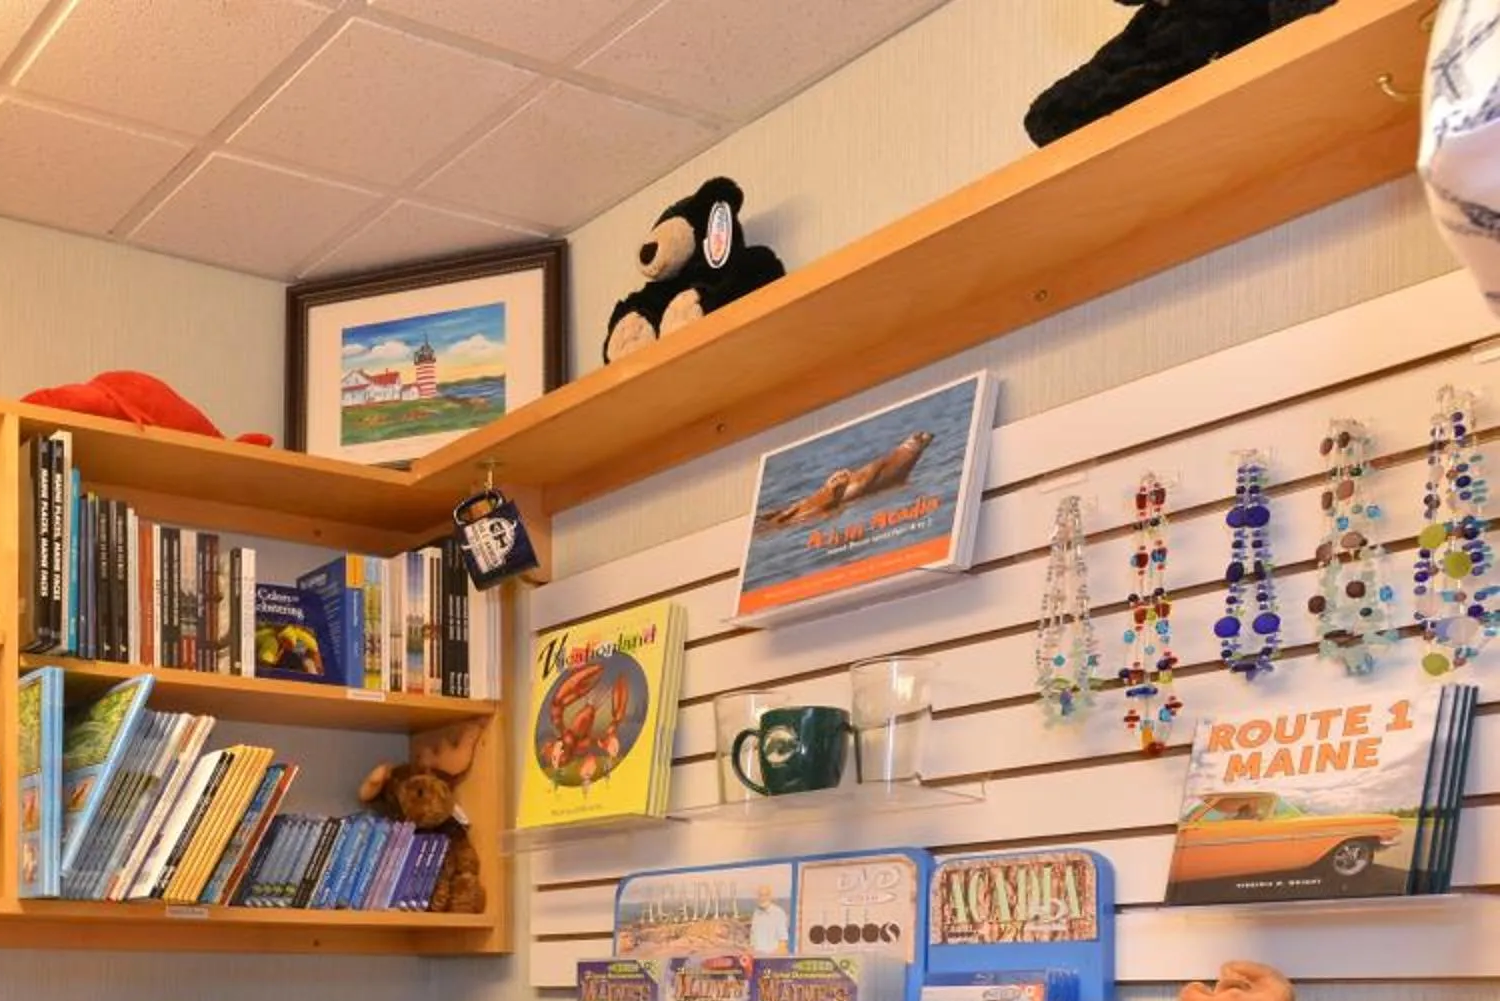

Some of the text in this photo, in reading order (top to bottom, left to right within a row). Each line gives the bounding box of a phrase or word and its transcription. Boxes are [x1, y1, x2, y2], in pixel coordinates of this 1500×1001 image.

[1206, 698, 1414, 752] ROUTE 1
[1223, 736, 1383, 783] MAINE
[950, 862, 1084, 923] ACADIA
